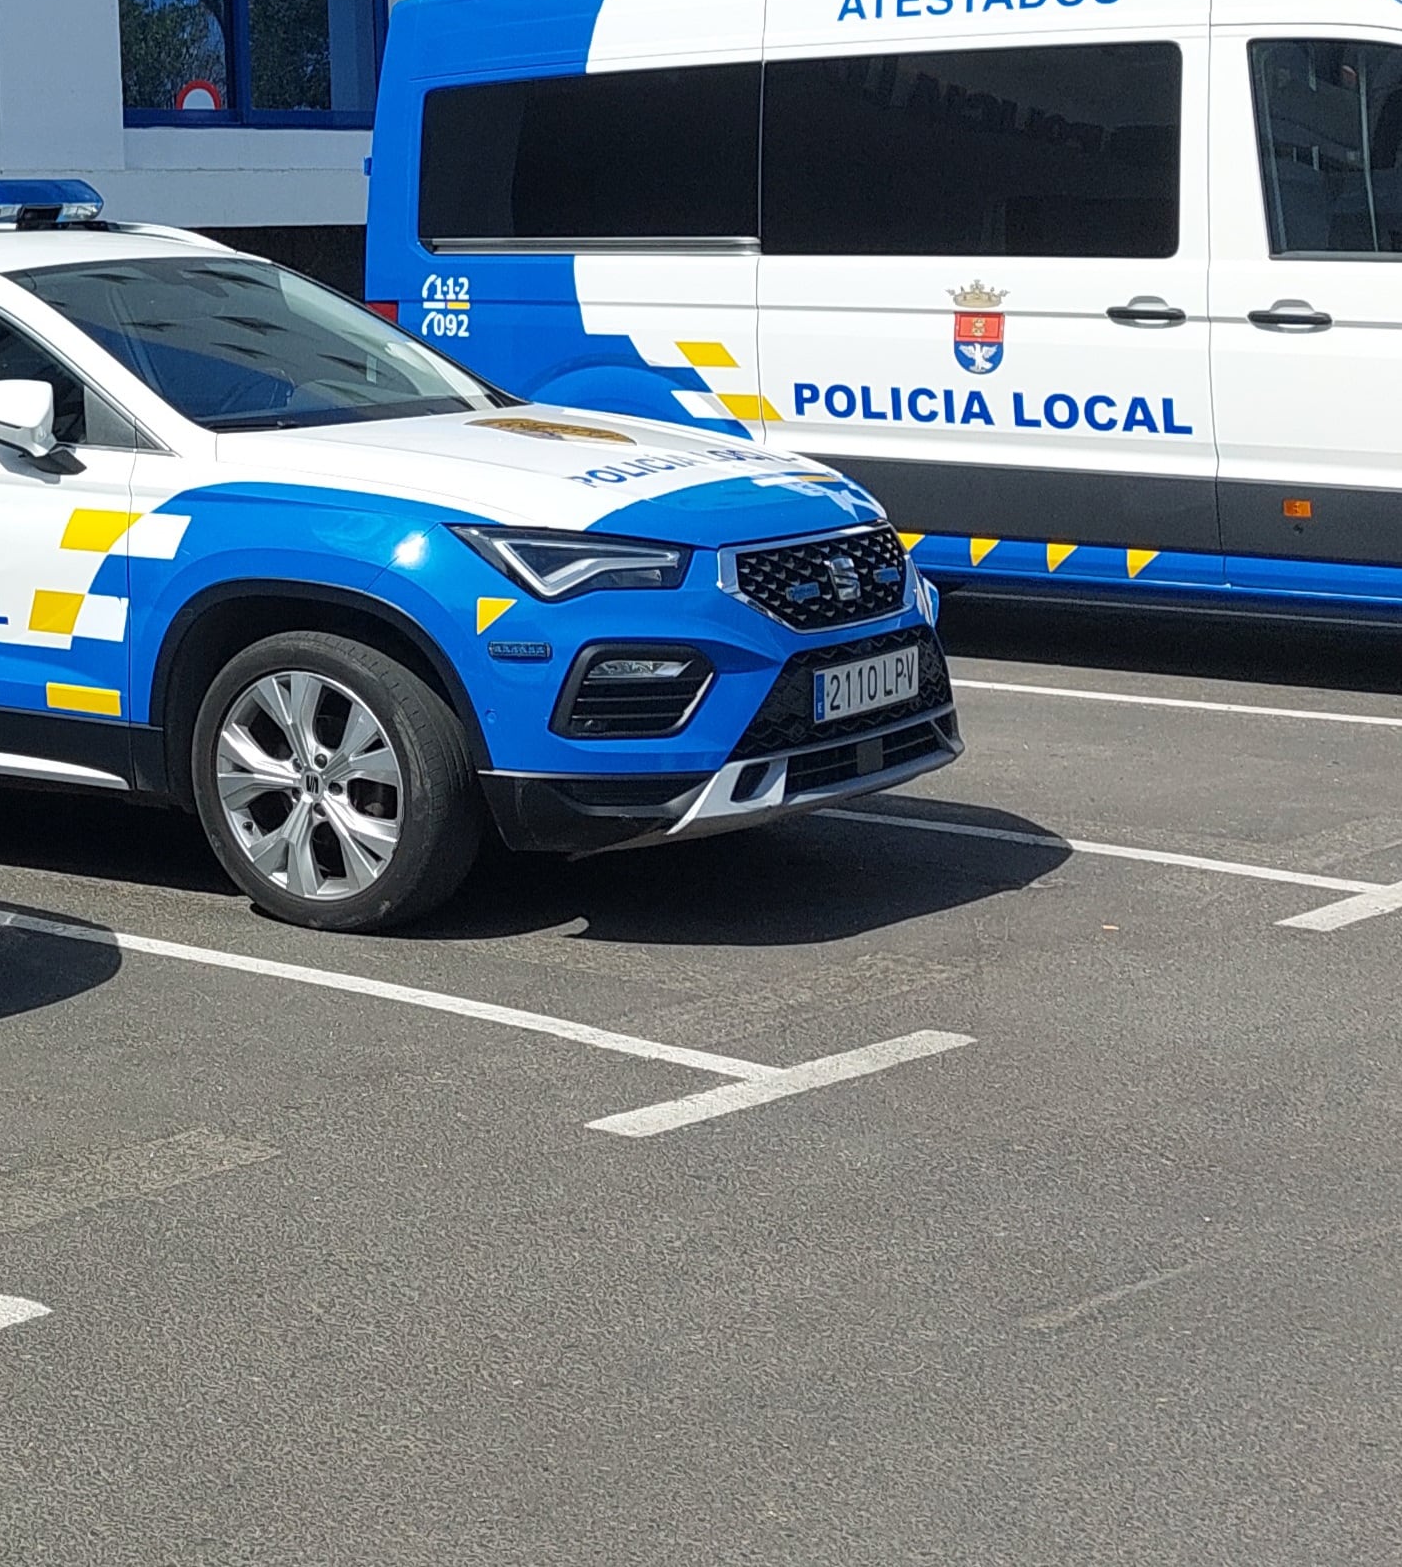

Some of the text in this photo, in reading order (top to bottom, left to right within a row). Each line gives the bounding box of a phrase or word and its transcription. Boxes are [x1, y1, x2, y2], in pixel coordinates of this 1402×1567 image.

[433, 313, 470, 338] 092
[793, 383, 1193, 435] POLICIA LOCAL
[829, 653, 915, 712] 2110 LPV
